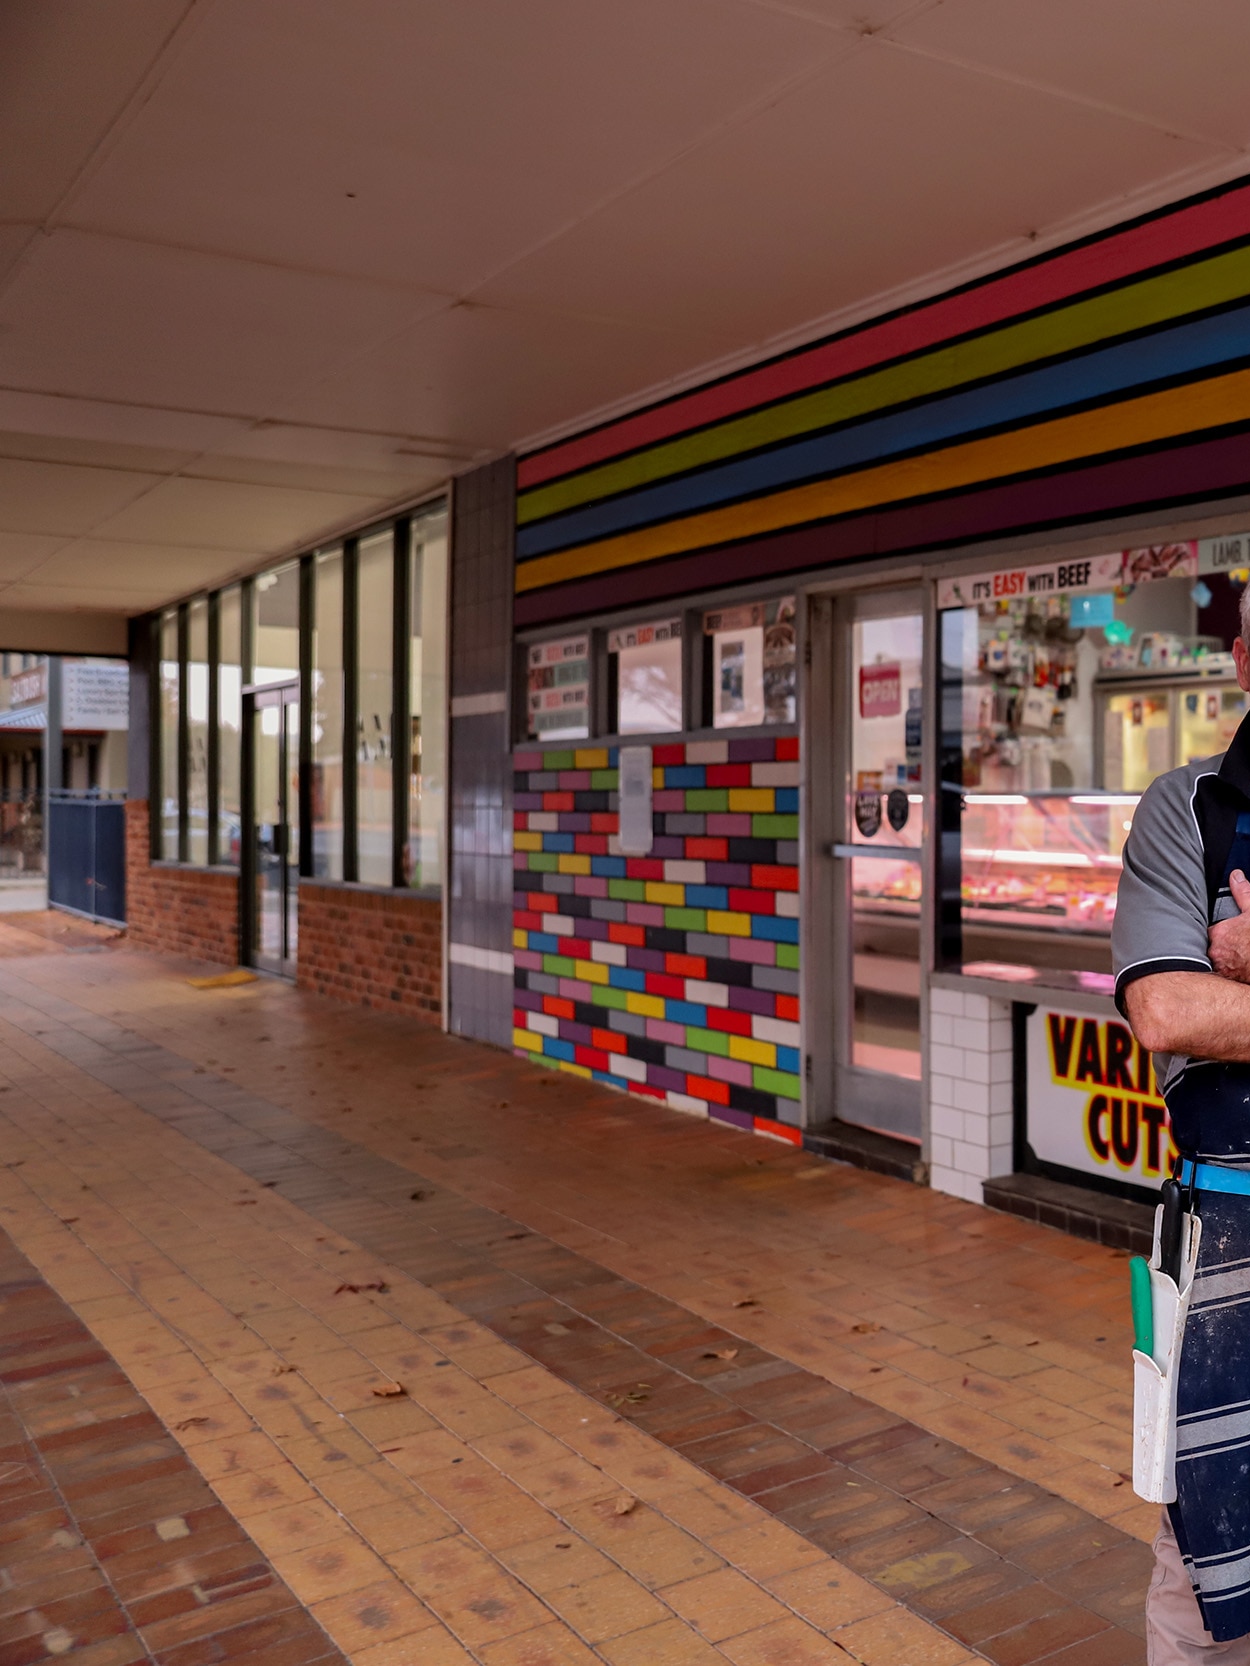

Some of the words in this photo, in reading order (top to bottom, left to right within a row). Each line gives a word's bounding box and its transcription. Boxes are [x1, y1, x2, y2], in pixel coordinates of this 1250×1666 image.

[1212, 540, 1245, 566] LAMB.
[973, 581, 991, 600] IT'S
[993, 571, 1026, 597] EASY
[1027, 573, 1055, 593] WITH
[1057, 562, 1091, 588] BEEF
[863, 679, 899, 702] OPEN
[1045, 1012, 1166, 1100] VARI
